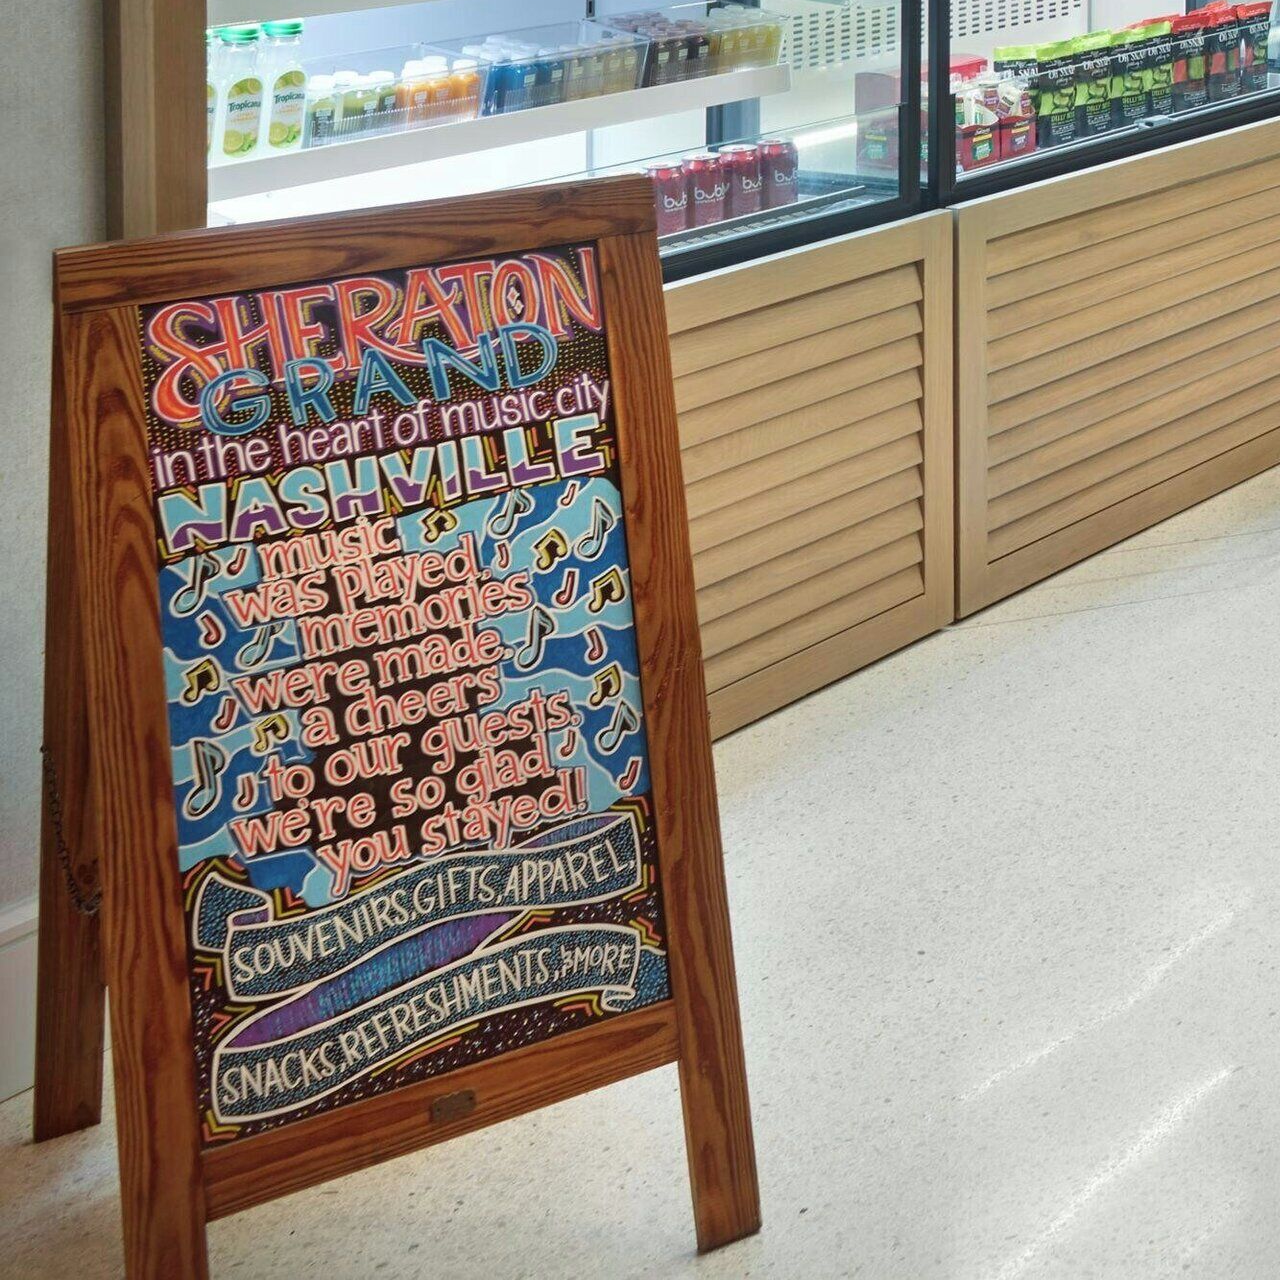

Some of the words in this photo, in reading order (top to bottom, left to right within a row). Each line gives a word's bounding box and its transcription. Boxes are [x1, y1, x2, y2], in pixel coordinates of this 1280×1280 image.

[150, 248, 603, 422] SHERATON
[200, 322, 558, 435] GRAND
[153, 448, 197, 488] in
[198, 434, 271, 477] the
[278, 410, 385, 470] heart
[395, 400, 441, 445] of
[448, 390, 551, 434] music
[555, 378, 609, 418] city
[157, 414, 605, 554] NASHVILLE
[257, 518, 399, 581] music
[224, 573, 330, 627] was
[302, 571, 532, 658] memories
[234, 663, 371, 714] were
[304, 706, 338, 748] a
[345, 666, 500, 732] cheers
[232, 793, 377, 856] we're
[389, 773, 445, 818] so
[457, 734, 551, 805] glad
[267, 752, 314, 802] to
[325, 734, 411, 786] our
[318, 827, 420, 895] you
[421, 767, 587, 854] stayed!
